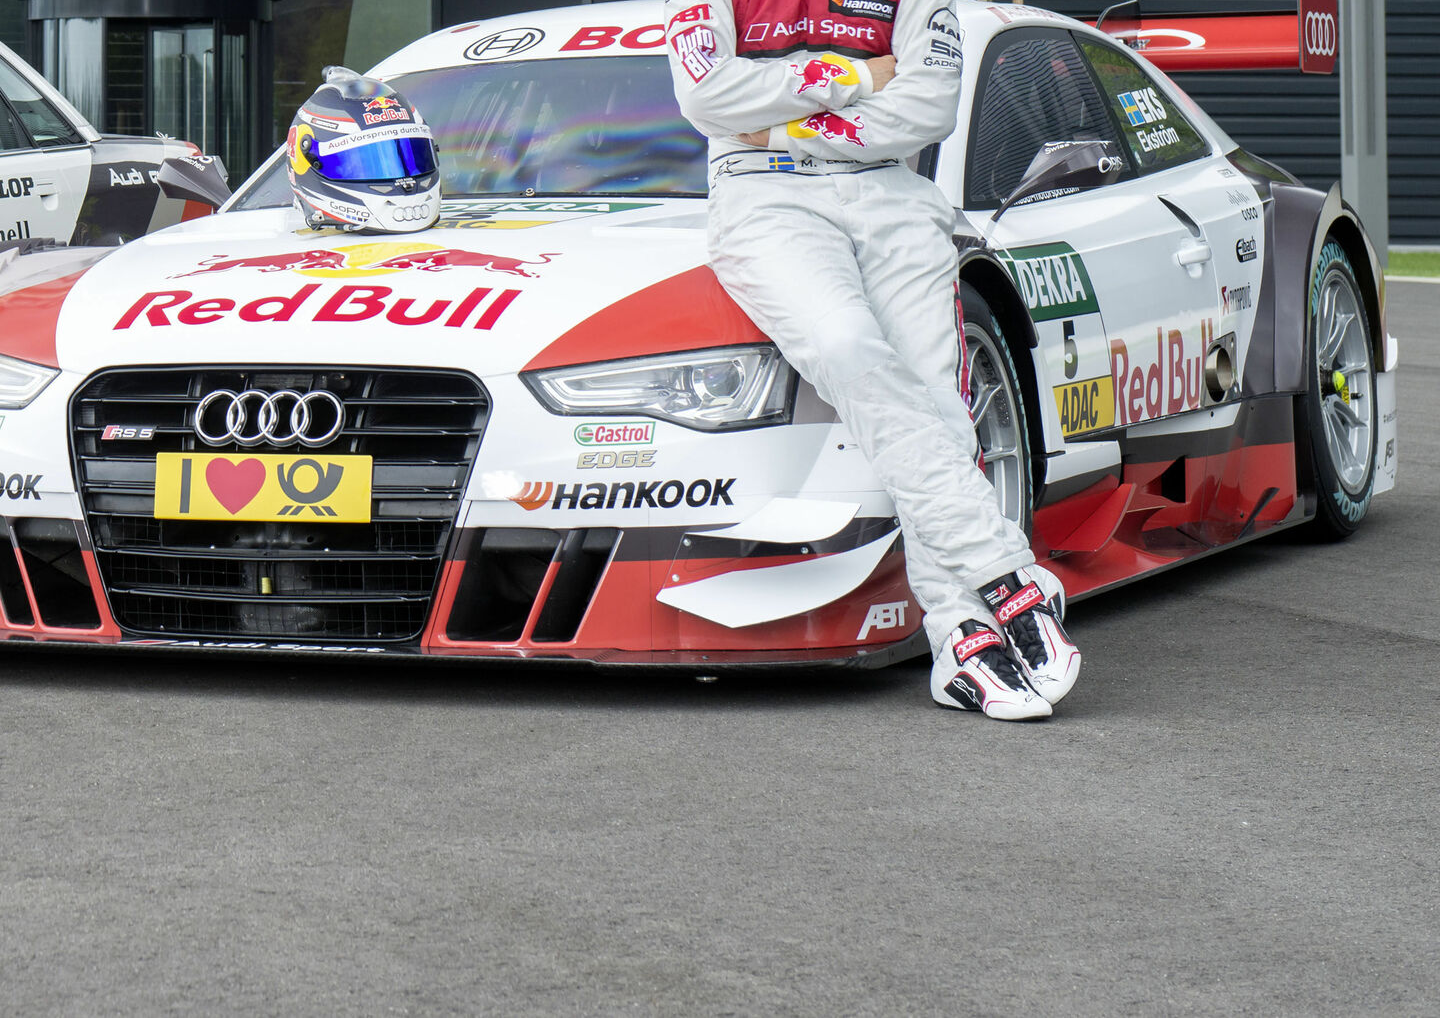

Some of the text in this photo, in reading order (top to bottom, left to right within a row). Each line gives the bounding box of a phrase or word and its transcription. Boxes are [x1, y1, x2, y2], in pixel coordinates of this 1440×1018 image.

[667, 3, 711, 33] ABT
[772, 17, 876, 40] Audi Sport
[558, 24, 666, 52] BO
[675, 26, 715, 61] Auto
[363, 108, 410, 126] Red Bull
[1130, 86, 1168, 124] EKS
[327, 139, 349, 150] Audi
[349, 129, 399, 144] Vorsprung
[399, 126, 420, 134] durch
[1136, 124, 1181, 153] Ekström
[108, 167, 145, 187] Audi
[1017, 253, 1087, 310] DEKRA
[112, 283, 523, 331] Red Bull
[1062, 319, 1079, 380] 5
[1110, 326, 1164, 425] Red
[1060, 381, 1099, 433] ADAC
[593, 423, 652, 444] Castrol
[576, 450, 657, 469] EDGE
[856, 599, 909, 640] ABT
